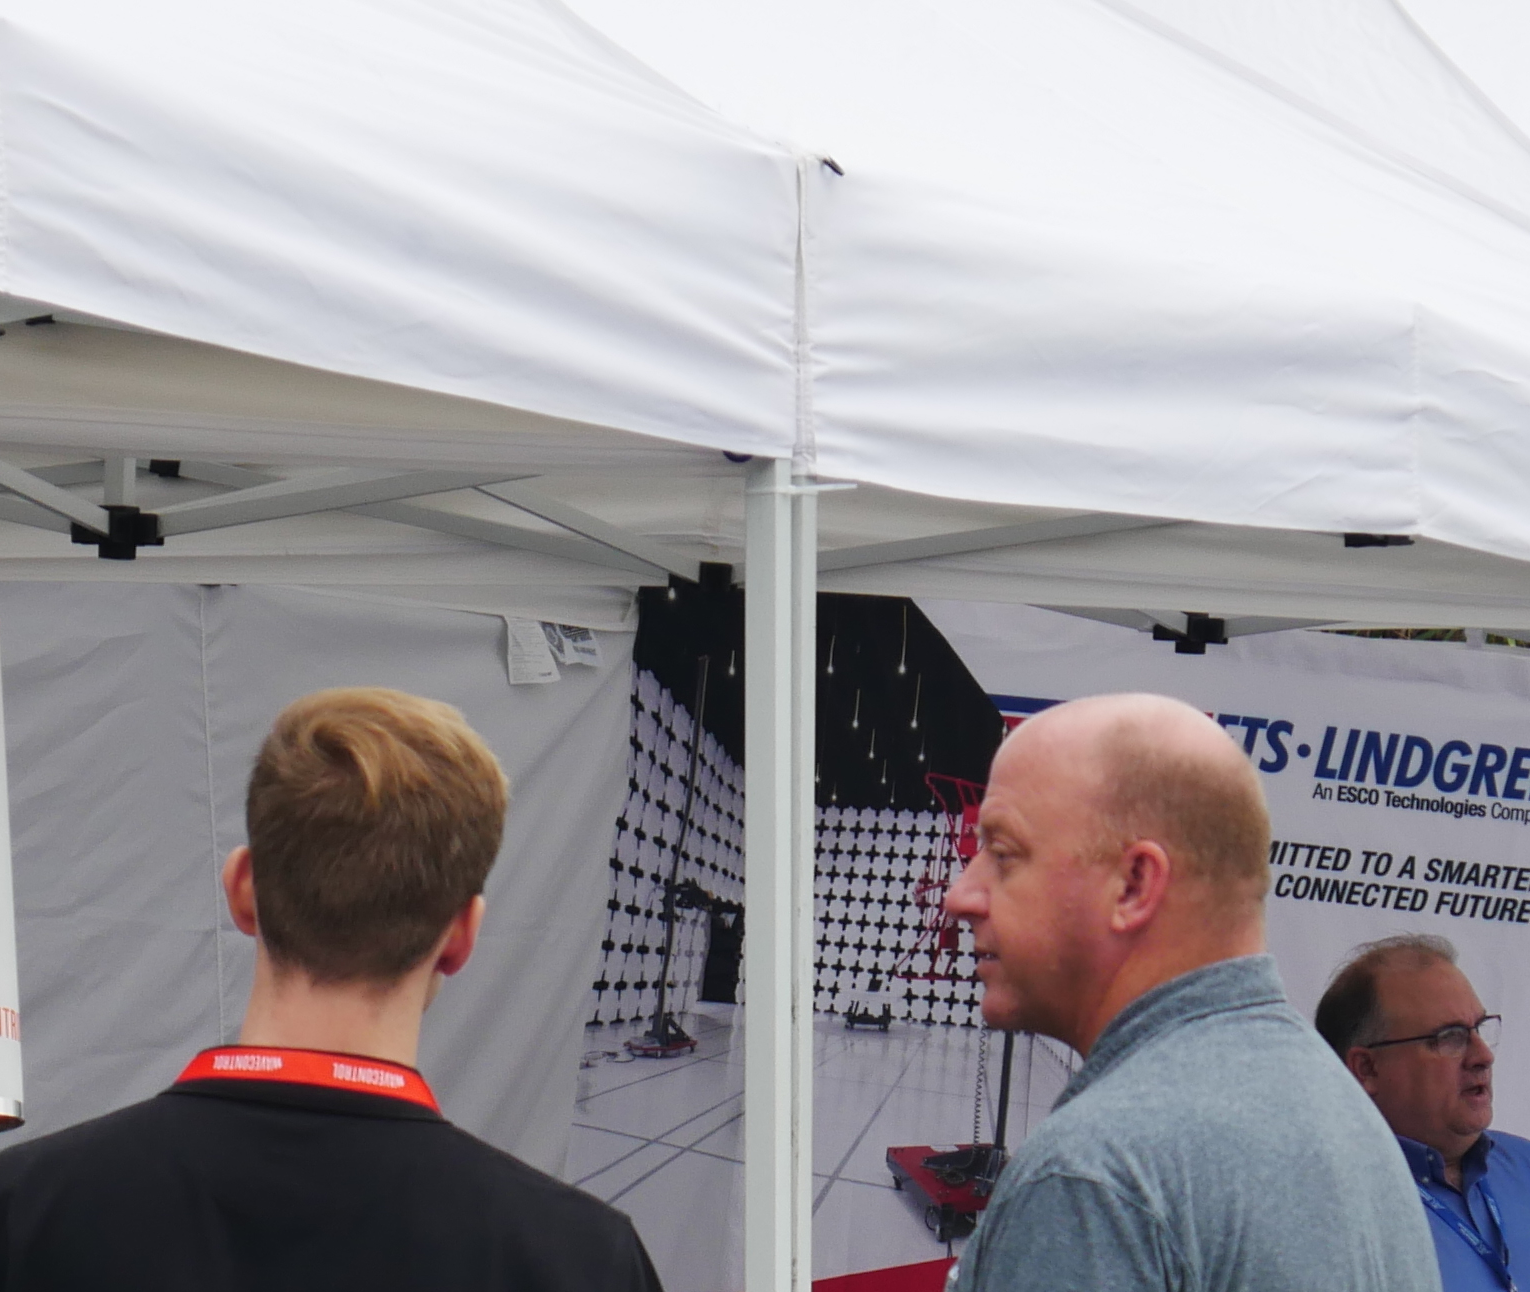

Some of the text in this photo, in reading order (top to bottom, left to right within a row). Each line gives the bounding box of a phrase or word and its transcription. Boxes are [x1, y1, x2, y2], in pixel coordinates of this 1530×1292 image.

[1312, 783, 1333, 800] An
[1336, 786, 1379, 806] ESCO
[1384, 791, 1487, 820] Technologies
[1360, 850, 1394, 877] TO
[1397, 855, 1417, 880] A
[1274, 873, 1429, 912] CONNECTED
